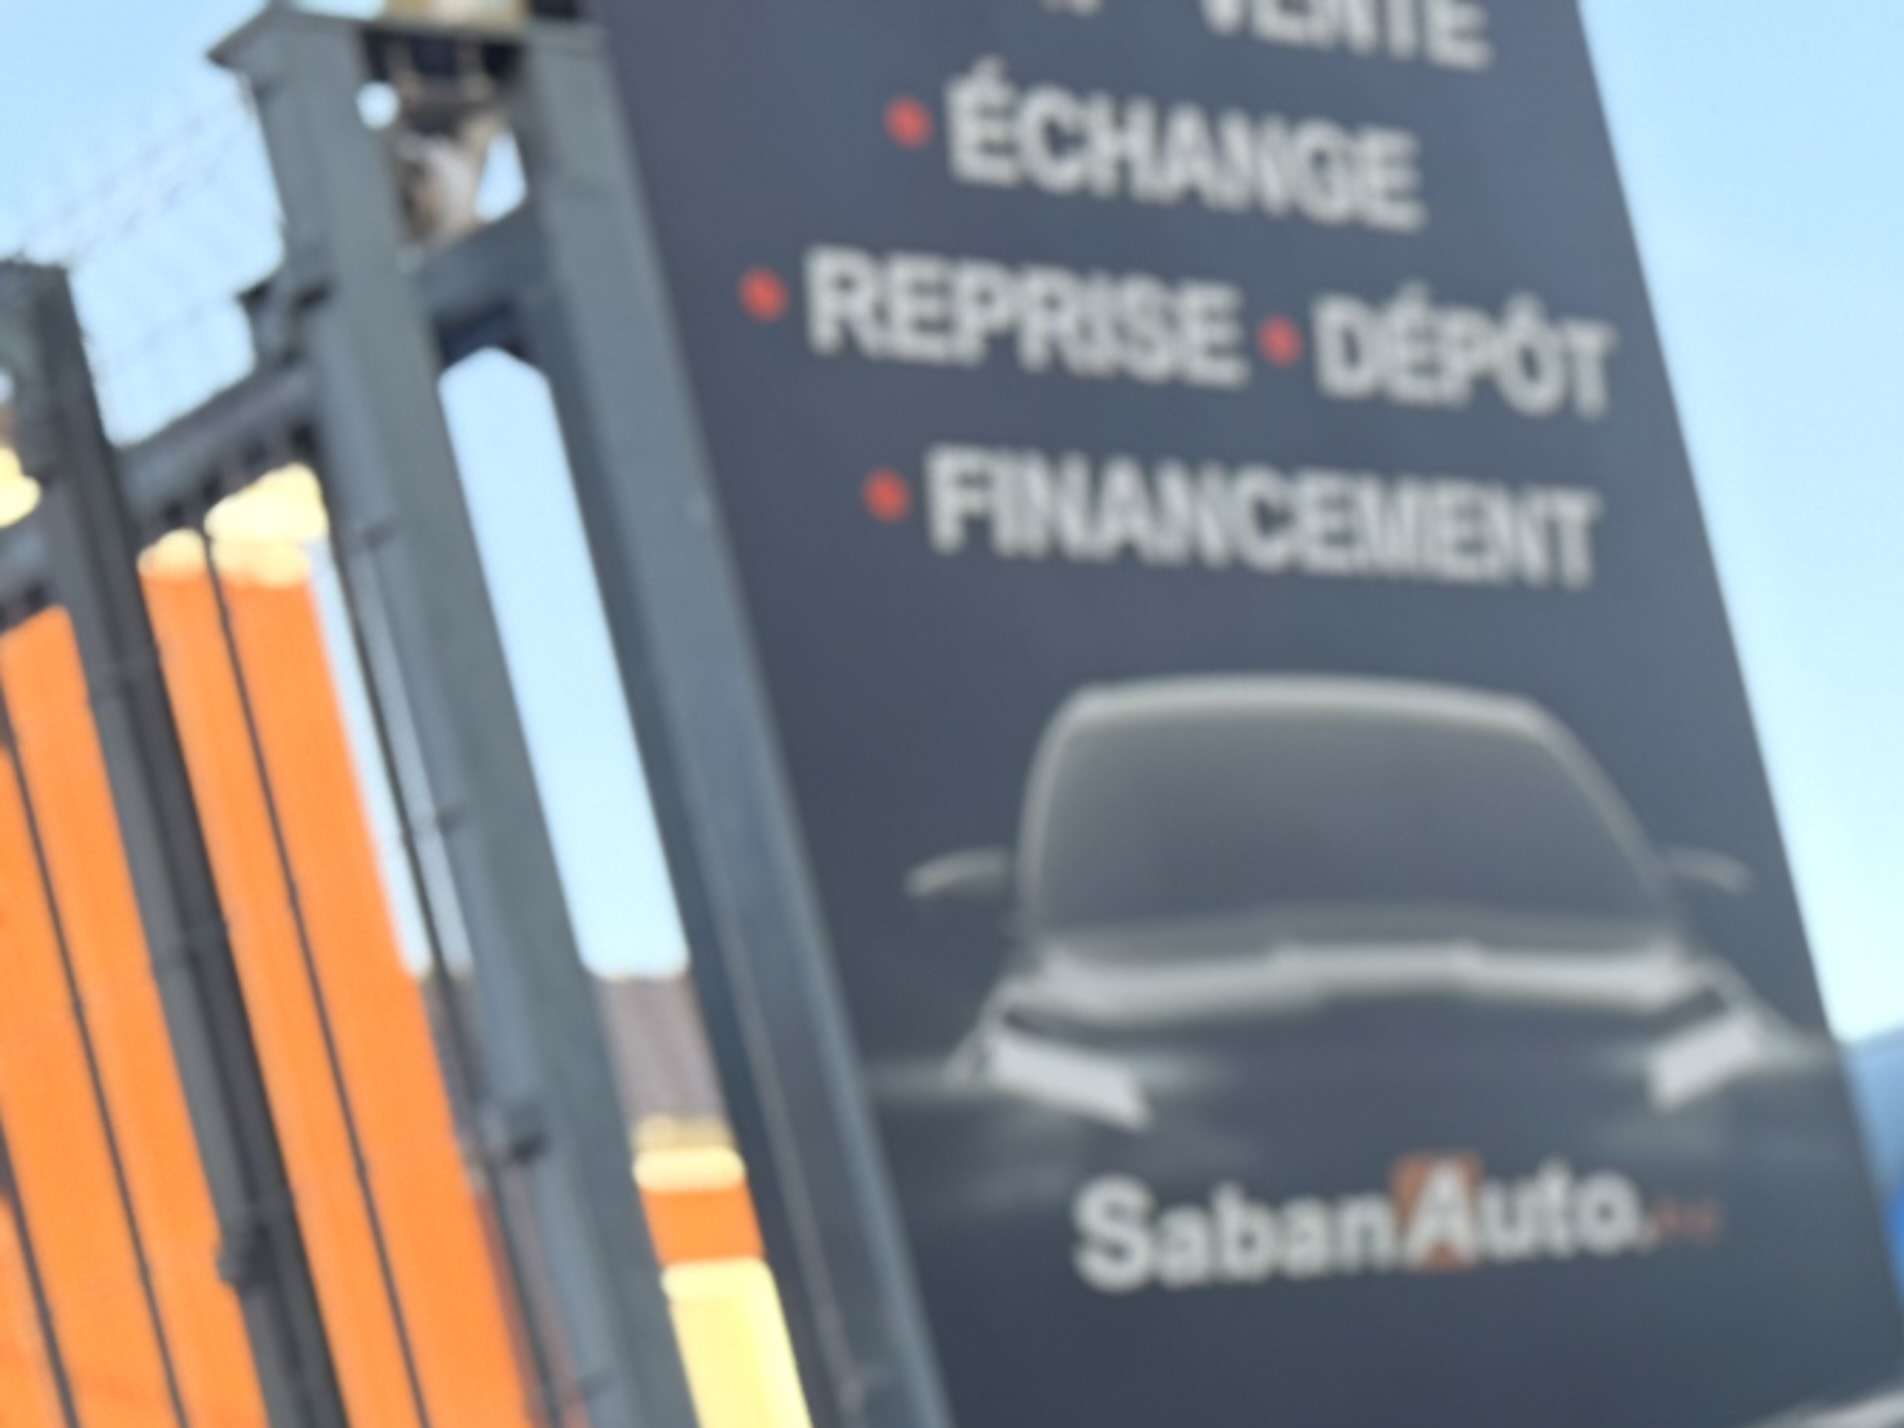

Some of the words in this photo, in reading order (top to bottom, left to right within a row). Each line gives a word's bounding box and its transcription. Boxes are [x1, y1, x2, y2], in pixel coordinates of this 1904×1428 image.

[944, 57, 1425, 234] ÉCHANGE
[804, 247, 1248, 389] REPRISE
[1312, 280, 1615, 418] DÉPÔT
[925, 446, 1600, 588] FINANCEMENT
